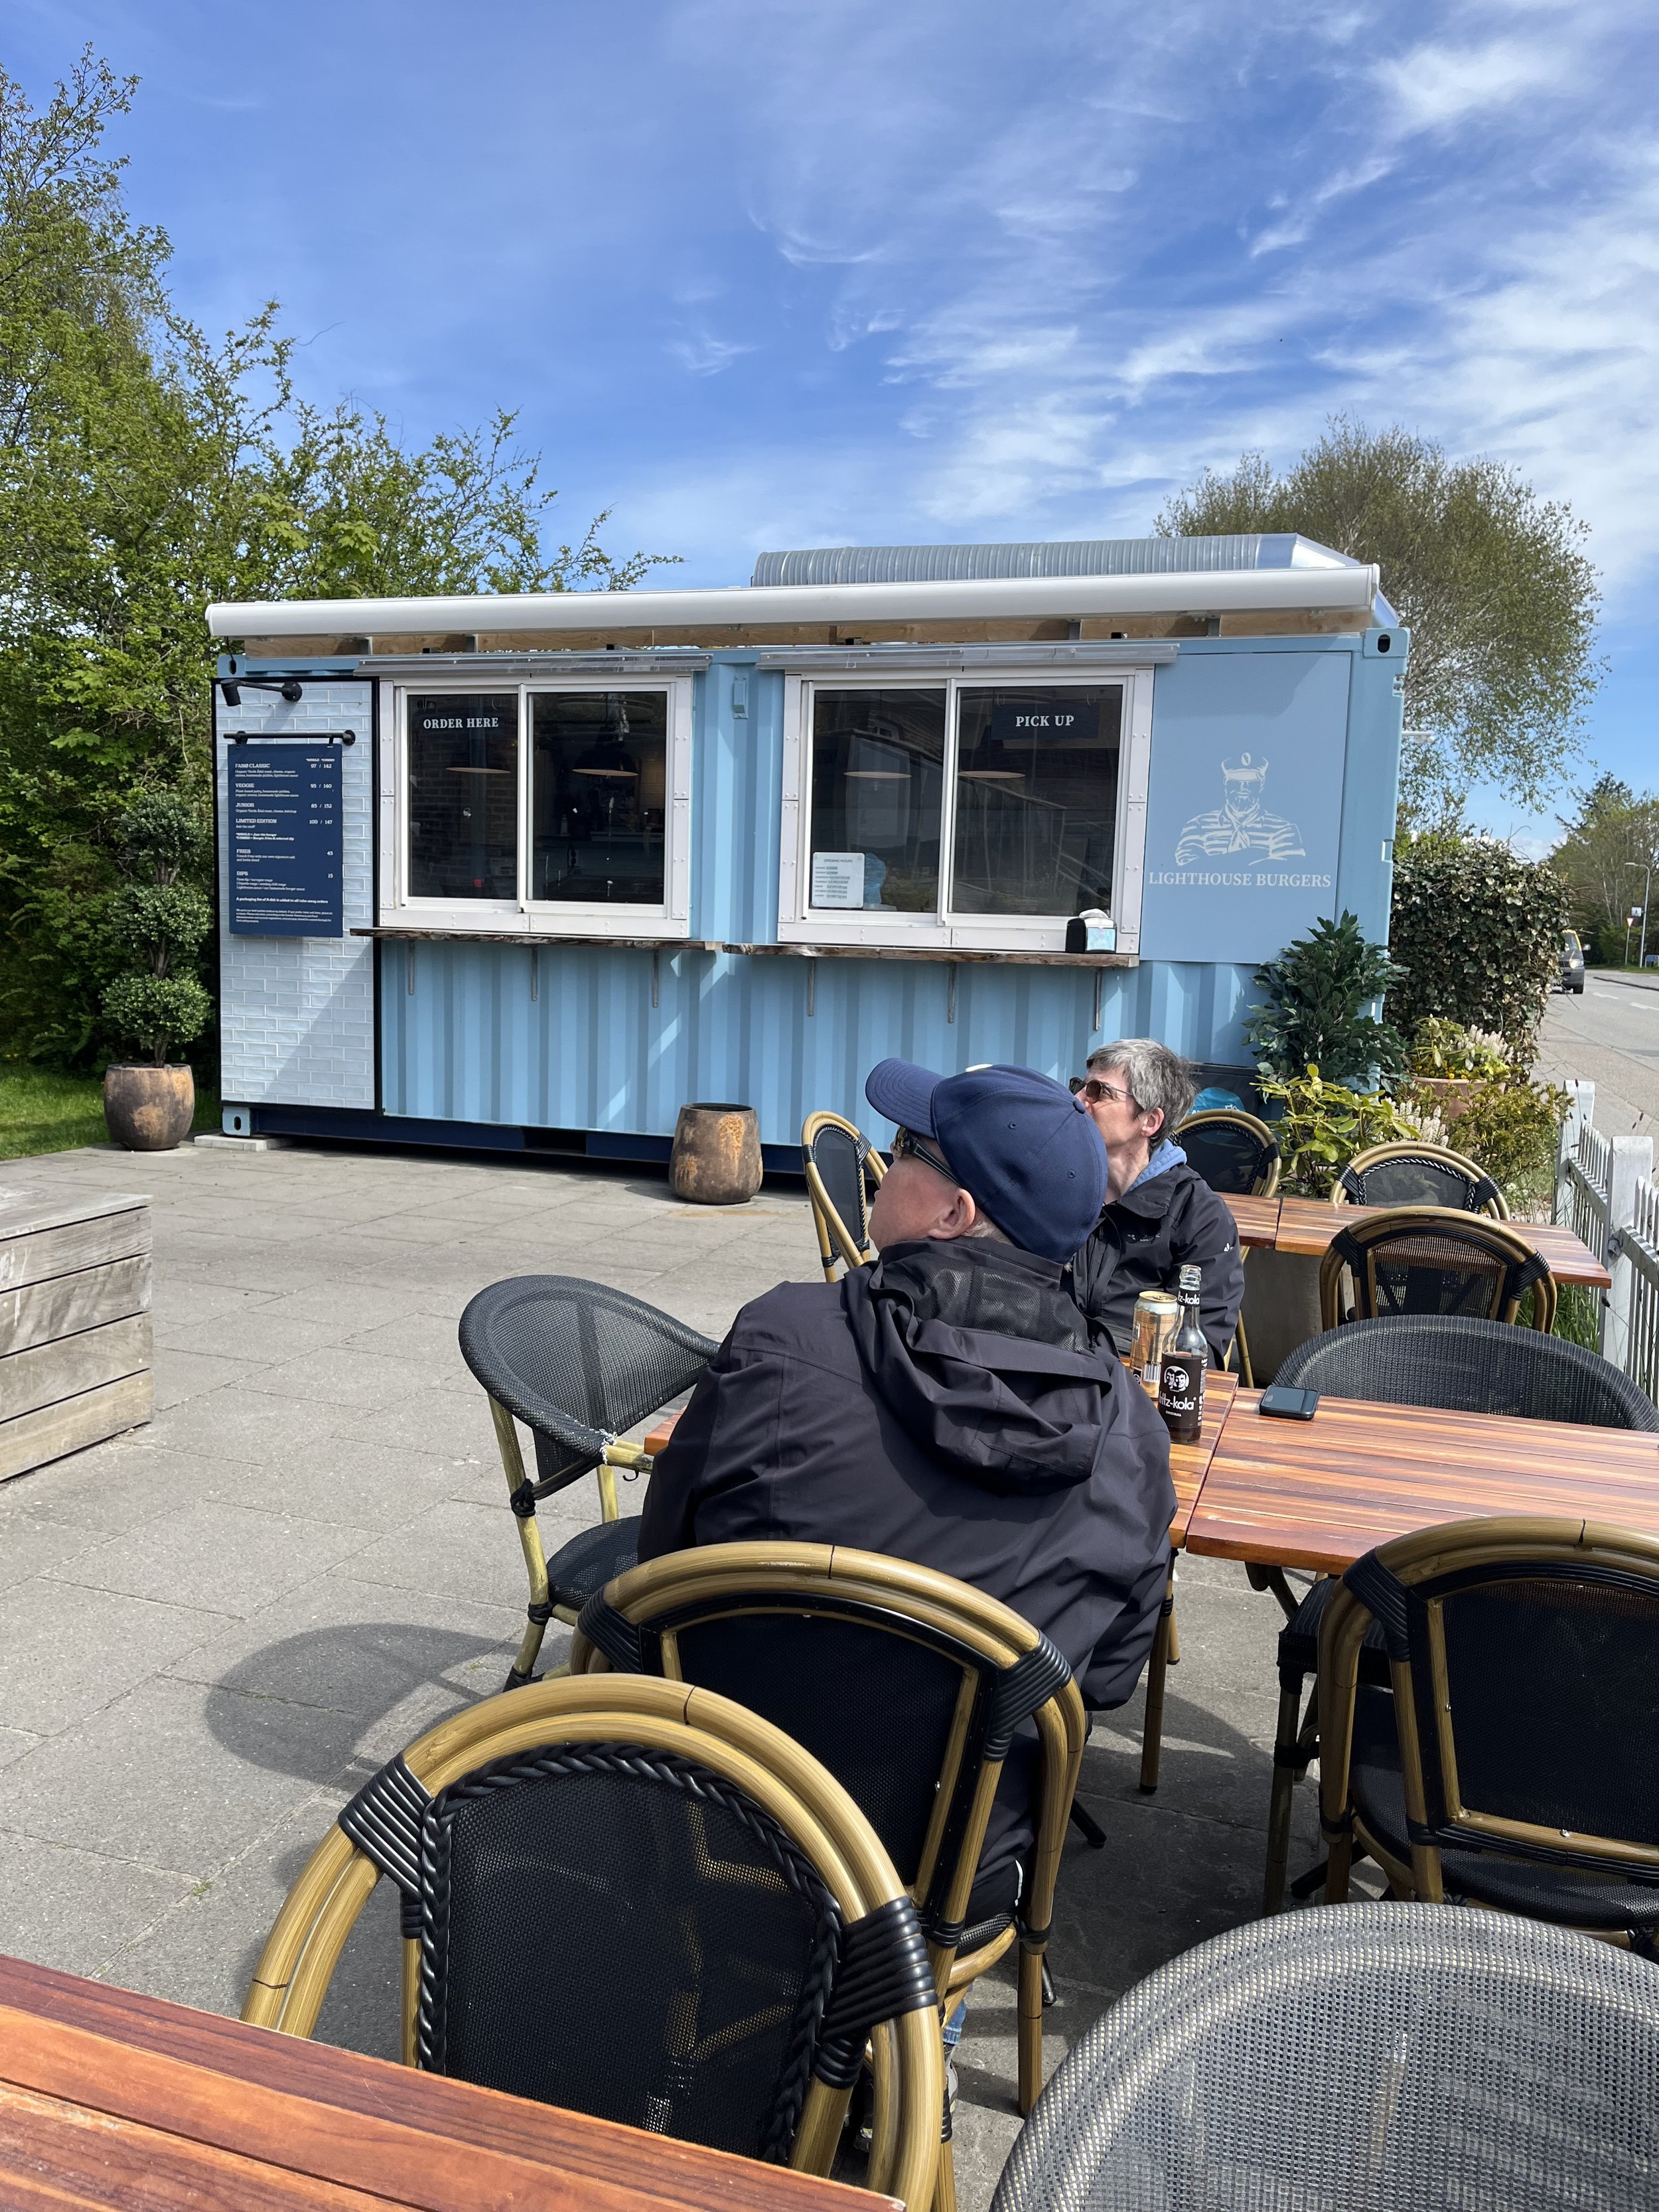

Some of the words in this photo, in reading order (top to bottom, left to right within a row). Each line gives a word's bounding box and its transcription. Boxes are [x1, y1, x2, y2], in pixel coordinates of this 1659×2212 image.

[423, 718, 463, 729] ORDER
[467, 717, 499, 728] HERE
[1015, 715, 1050, 727] PICK
[1054, 715, 1074, 726] UP
[1149, 871, 1252, 885] LIGHTHOUSE
[1256, 873, 1331, 887] BURGERS
